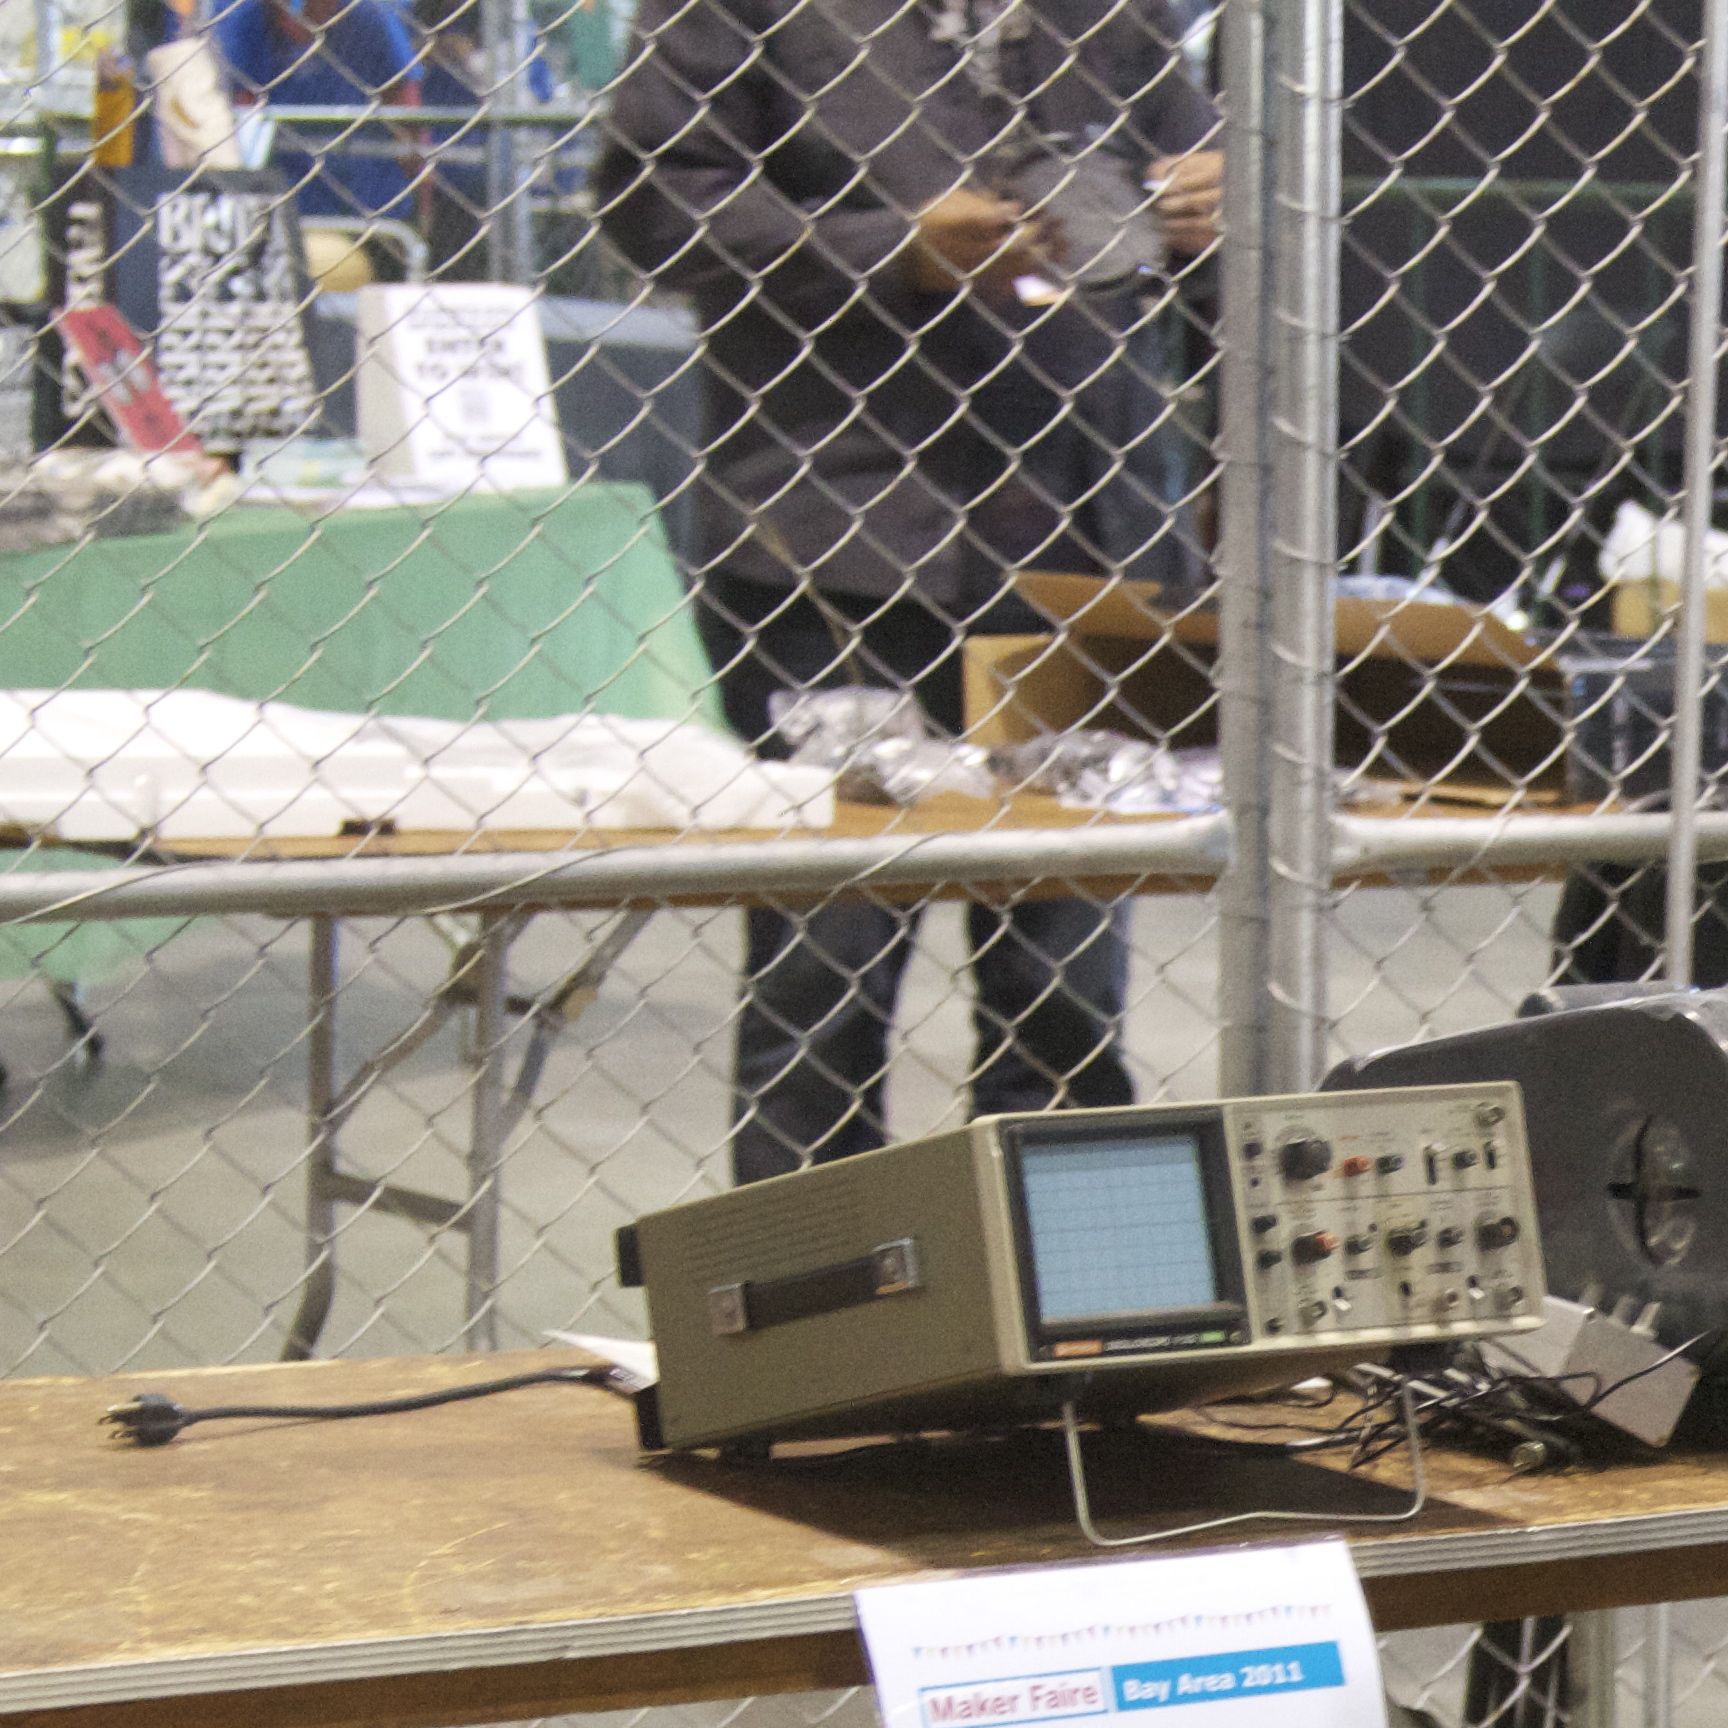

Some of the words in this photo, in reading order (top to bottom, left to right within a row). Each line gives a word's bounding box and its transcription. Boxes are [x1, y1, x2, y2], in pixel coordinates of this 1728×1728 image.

[931, 1688, 1019, 1723] Maker
[1029, 1681, 1098, 1710] Faire
[1123, 1677, 1171, 1703] Bay
[1177, 1670, 1236, 1695] Area
[1242, 1659, 1304, 1689] 2011
